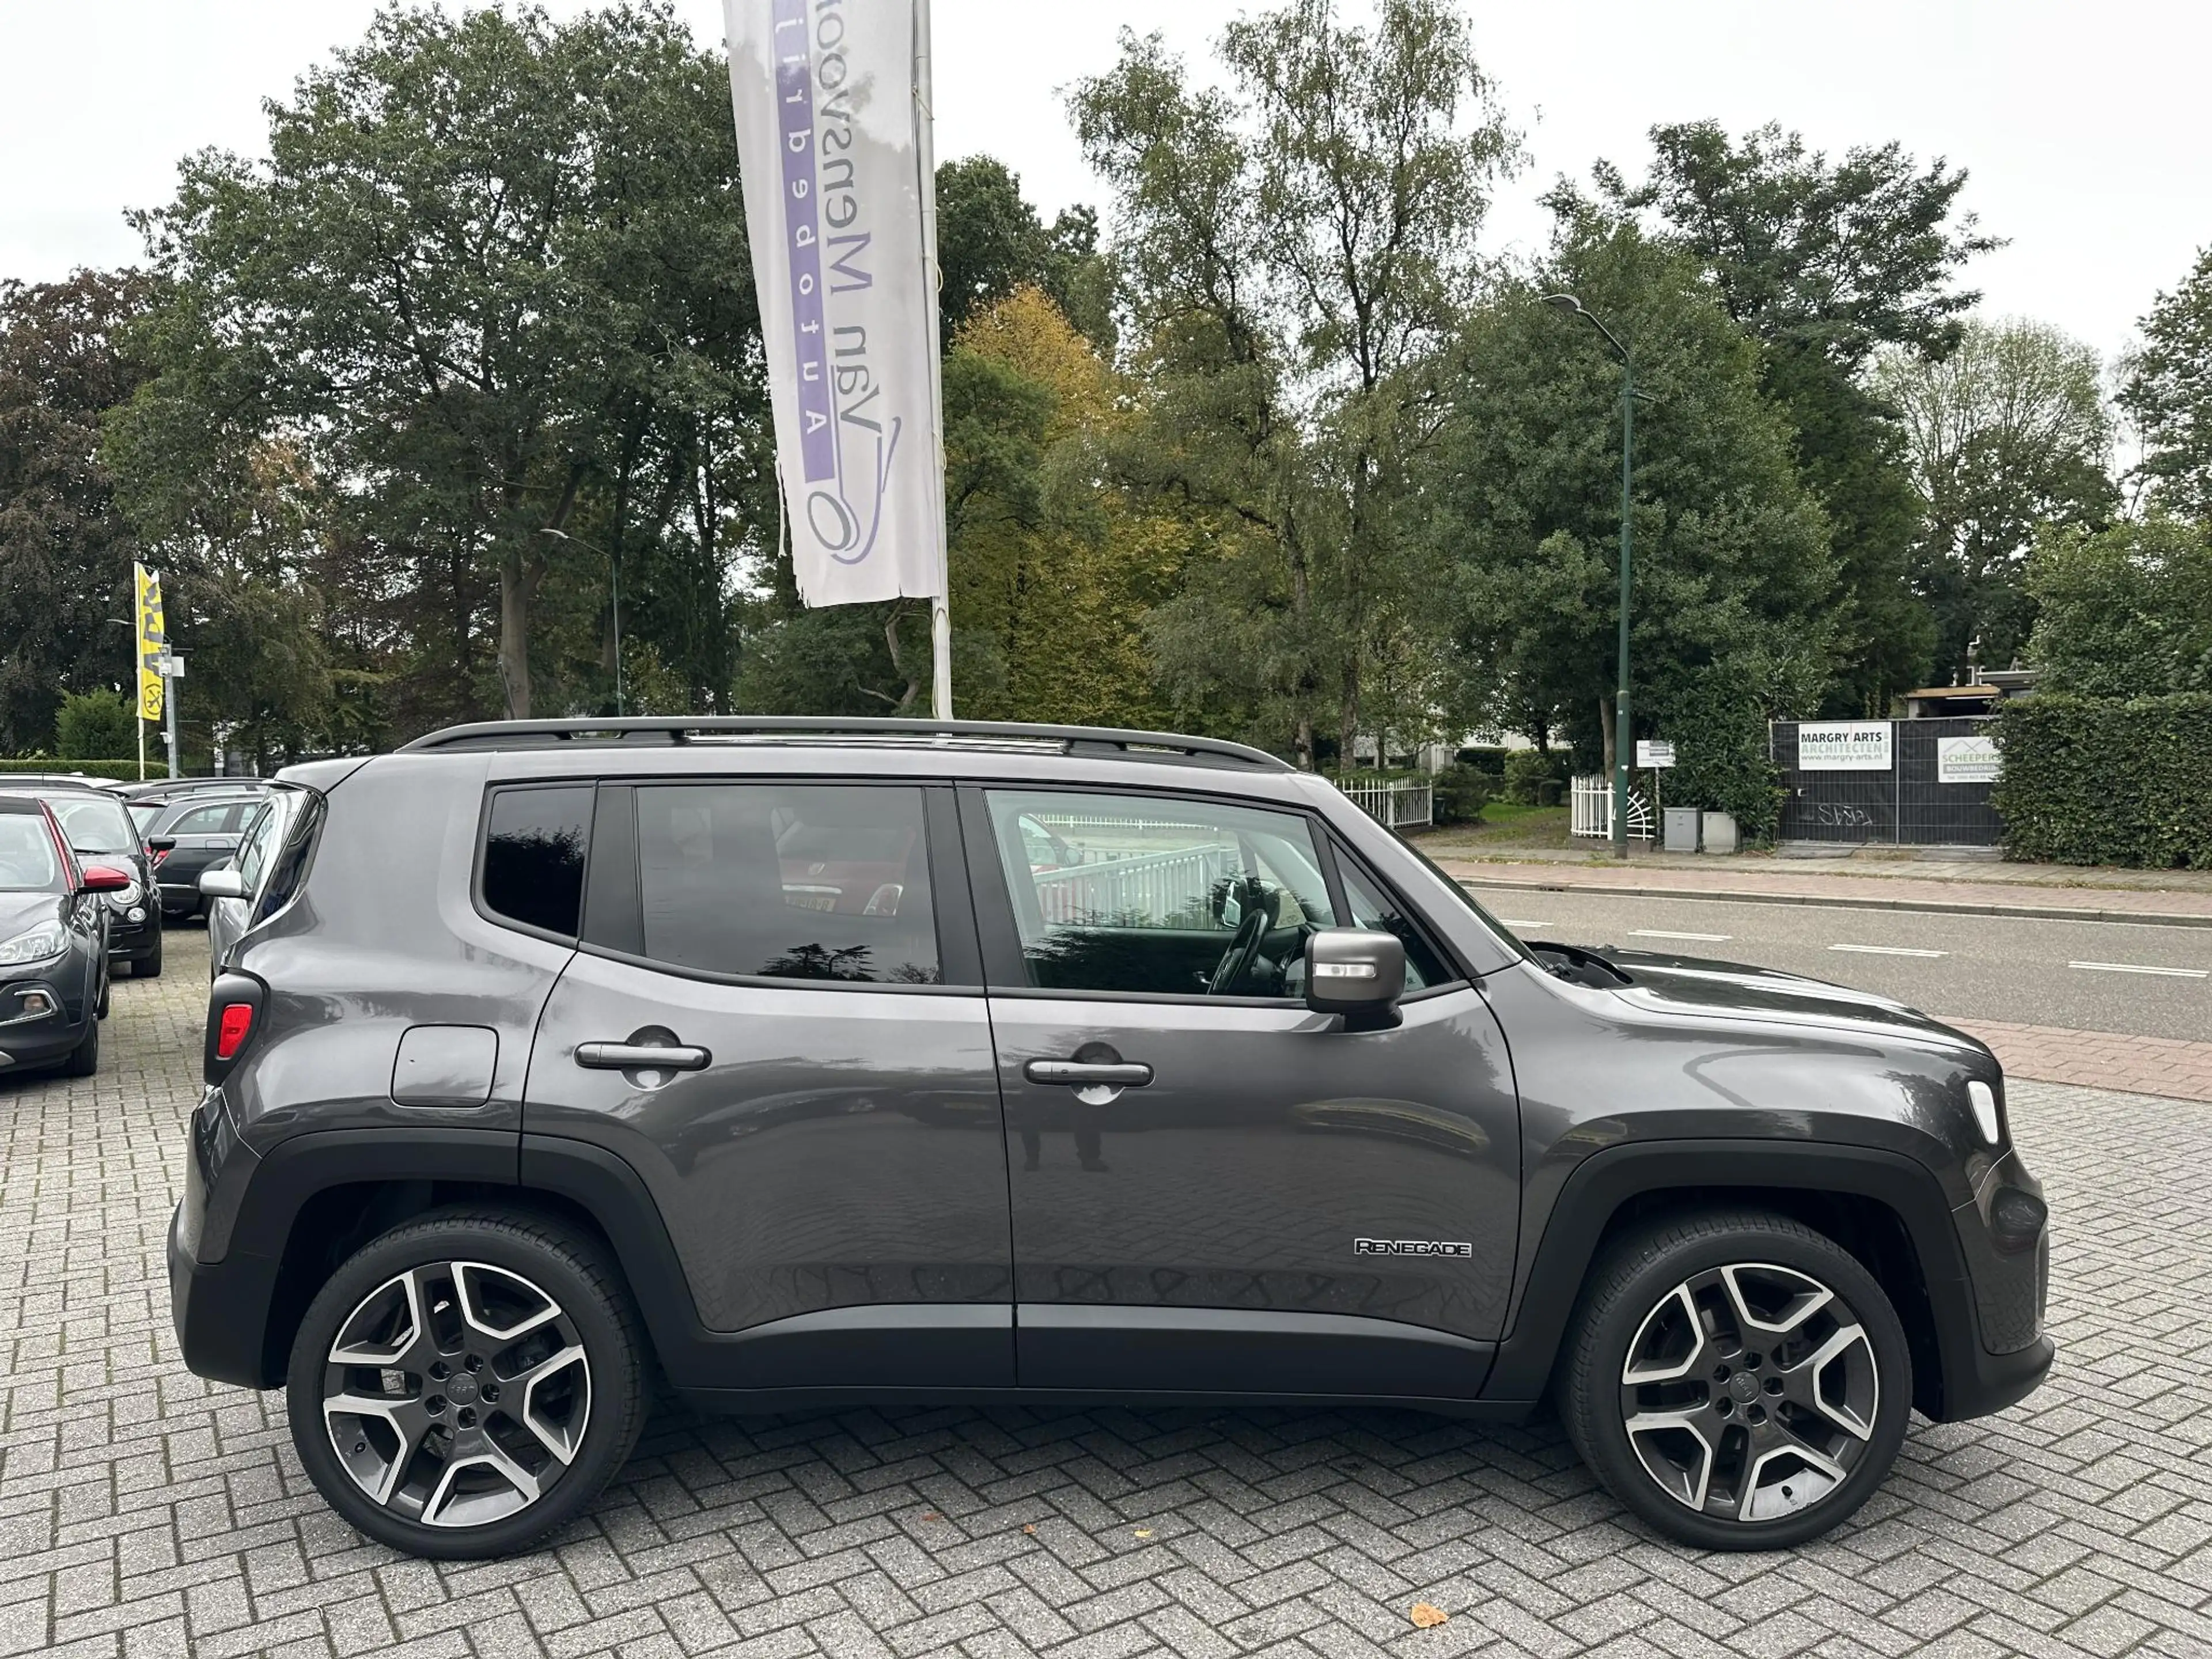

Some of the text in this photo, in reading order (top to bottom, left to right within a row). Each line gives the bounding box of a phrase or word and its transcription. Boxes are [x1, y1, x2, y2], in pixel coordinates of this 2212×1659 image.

[1801, 733, 1849, 743] MARGRY
[1854, 732, 1882, 742] ARTS
[1801, 743, 1882, 753] ARCHITECTEN
[1801, 753, 1883, 762] www.margry-arts.nl
[1354, 1238, 1472, 1257] RENEGADE
